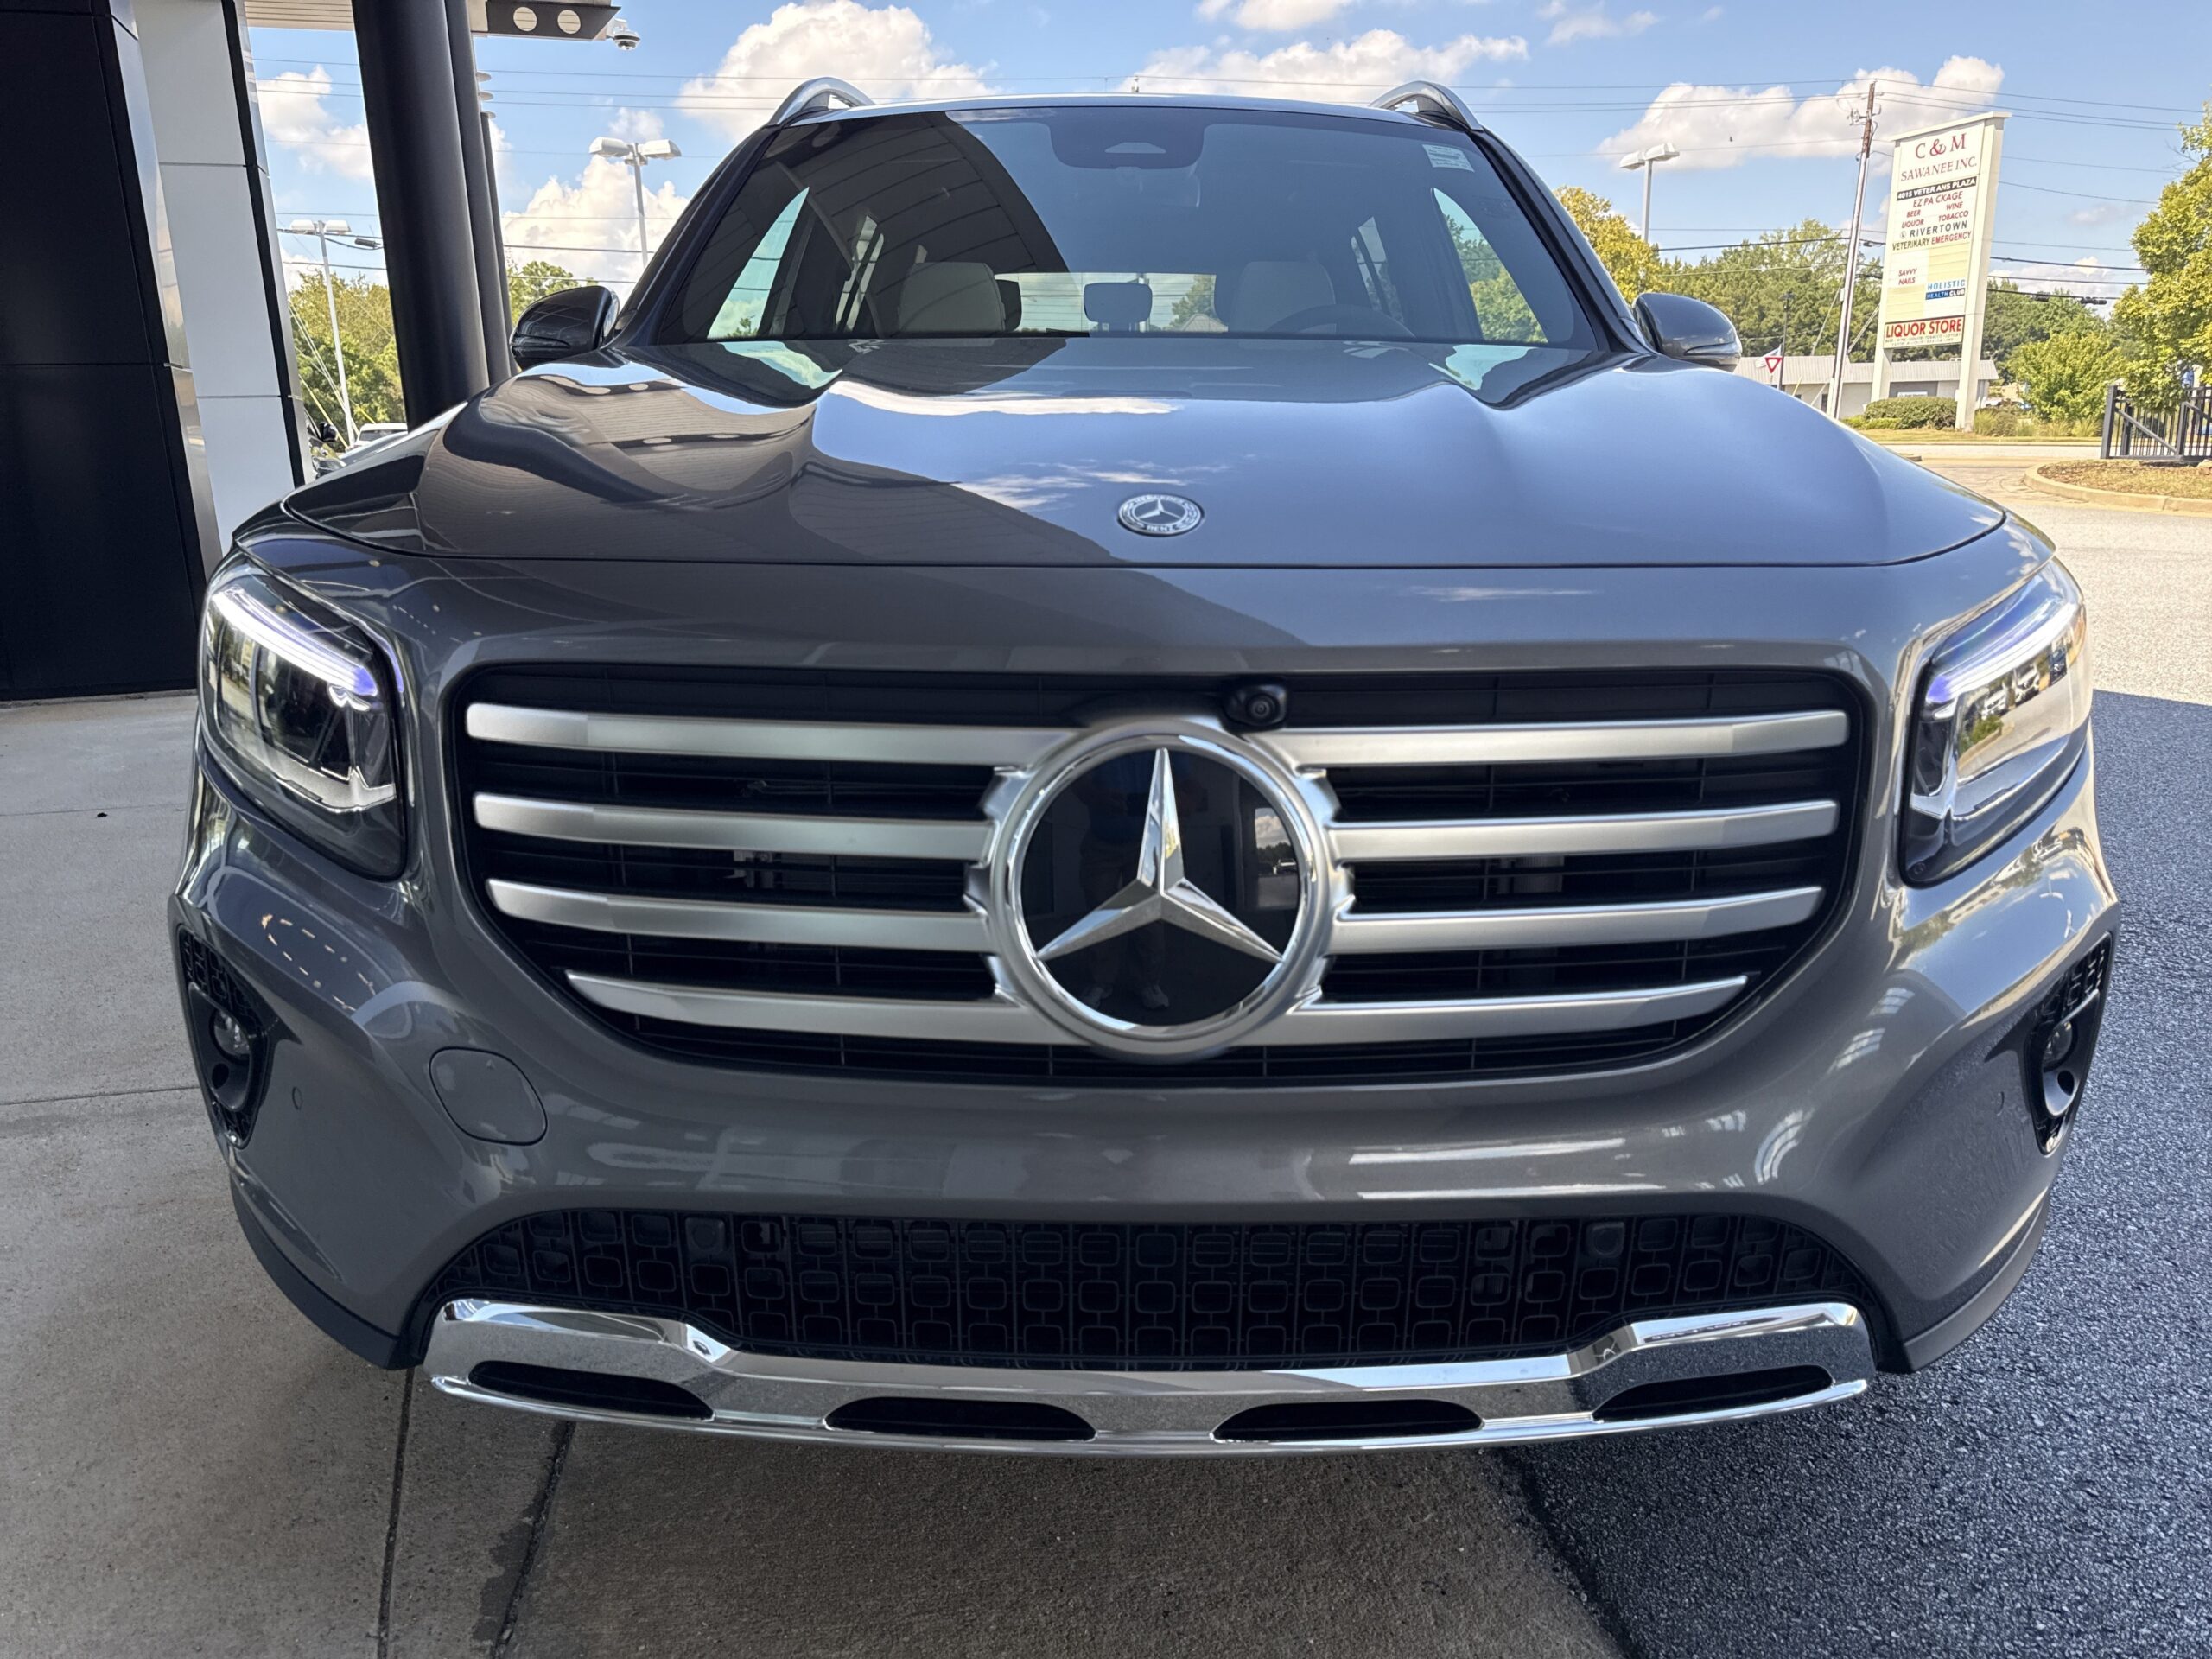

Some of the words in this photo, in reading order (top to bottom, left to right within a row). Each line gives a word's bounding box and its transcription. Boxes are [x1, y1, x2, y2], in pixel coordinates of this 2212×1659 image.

[1916, 143, 1925, 159] C
[1929, 138, 1946, 156] &
[1949, 132, 1967, 152] M
[1901, 161, 1954, 181] SAWANEE
[1955, 156, 1977, 170] INC.
[1952, 178, 1975, 188] PLAZA
[1913, 199, 1923, 207] EZ
[1946, 201, 1963, 210] WINE
[1906, 209, 1921, 218] BEER
[1938, 210, 1969, 222] TOBACCO
[1901, 219, 1924, 229] LIQUOR
[1910, 220, 1967, 238] RIVERTOWN
[1892, 238, 1929, 251] VETERINARY
[1931, 231, 1971, 245] EMERGENCY
[1898, 268, 1917, 276] SAVVY
[1898, 276, 1916, 285] NAILS
[1927, 279, 1966, 290] HOLISTIC
[1927, 290, 1948, 299] HEALTH
[1885, 322, 1926, 338] LIQUOR
[1929, 319, 1962, 334] STORE
